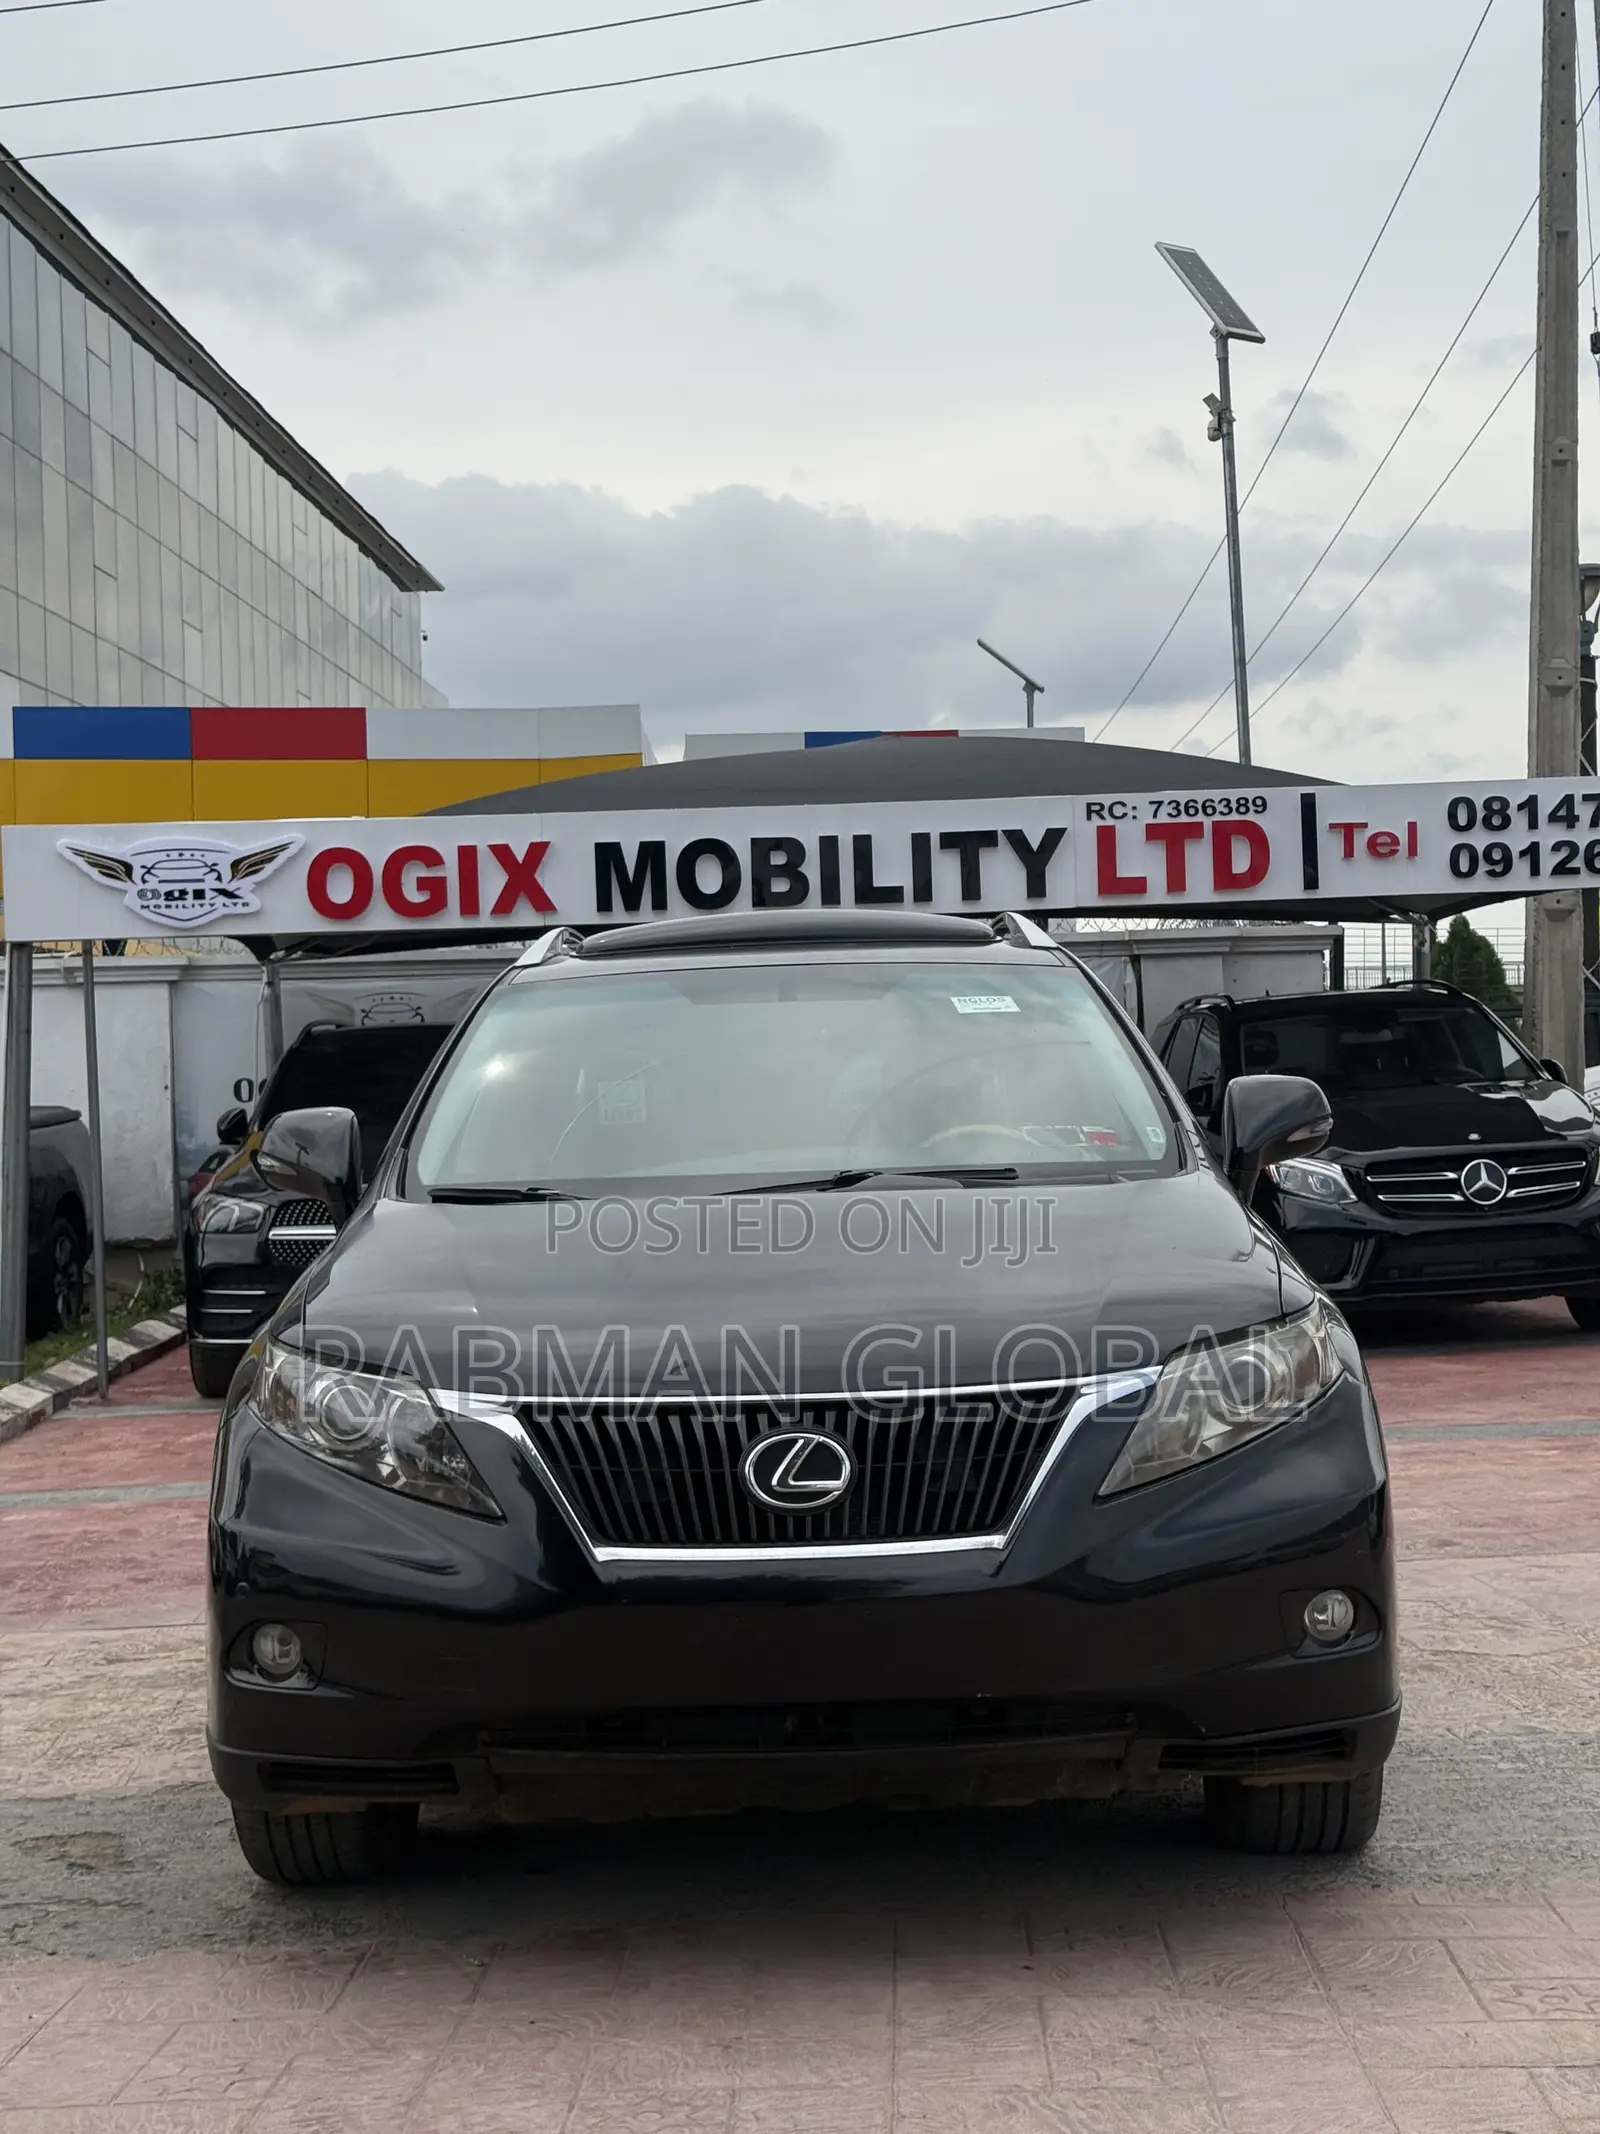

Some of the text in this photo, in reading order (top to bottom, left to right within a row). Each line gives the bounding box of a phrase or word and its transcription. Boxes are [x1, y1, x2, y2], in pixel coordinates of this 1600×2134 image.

[1086, 796, 1268, 821] RC: 7366389
[307, 820, 1418, 919] OGIX MOBILITY LTD Tel
